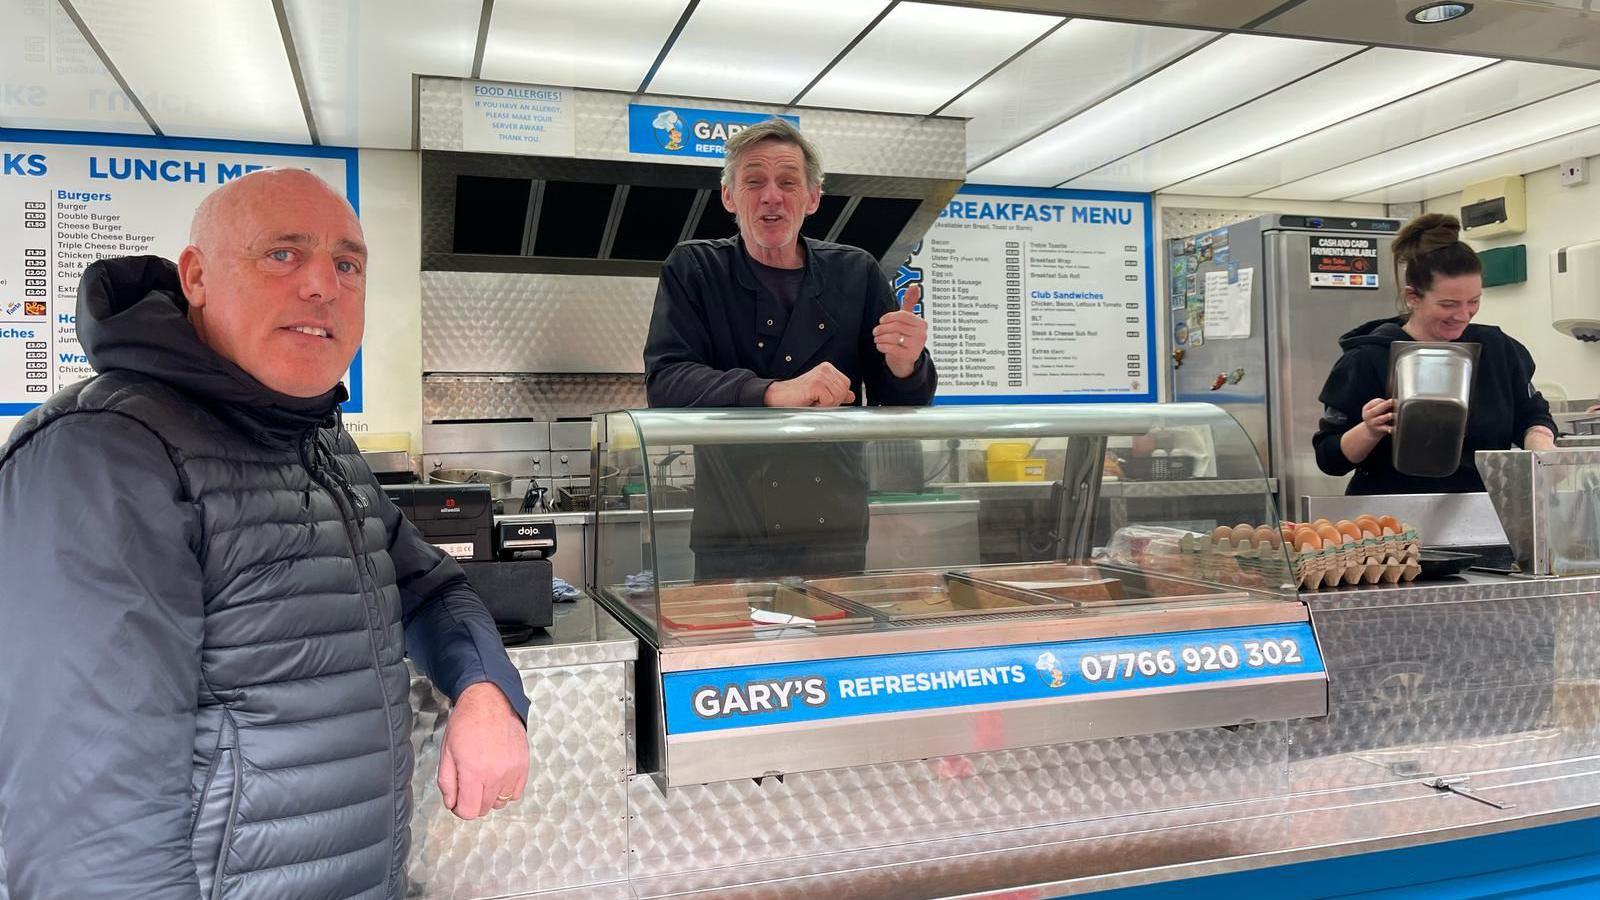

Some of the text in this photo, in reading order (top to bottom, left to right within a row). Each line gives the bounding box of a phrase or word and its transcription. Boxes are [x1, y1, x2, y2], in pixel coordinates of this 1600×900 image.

[475, 86, 561, 101] FOOD ALLERGIES!
[486, 111, 510, 119] PLEASE
[492, 122, 518, 130] SERVER
[694, 121, 747, 140] GAR
[3, 153, 47, 176] KS
[90, 157, 206, 184] LUNCH
[57, 190, 112, 202] Burgers
[57, 202, 87, 211] Burger
[57, 213, 120, 222] Double Burger
[1072, 206, 1132, 225] MENU
[58, 222, 122, 232] Cheese Burger
[58, 232, 155, 242] Double Cheese Burger
[58, 242, 148, 252] Triple Cheese Burger
[1319, 238, 1369, 248] CASH AND CARD
[58, 252, 93, 260] Chicken
[1311, 247, 1377, 257] PAYMENTS AVAILABLE
[58, 261, 75, 269] Salt
[1031, 291, 1104, 300] Club Sandwiches
[0, 328, 34, 338] iches
[1081, 639, 1302, 681] 07766 920 302
[694, 665, 1026, 717] GARY'S REFRESHMENTS
